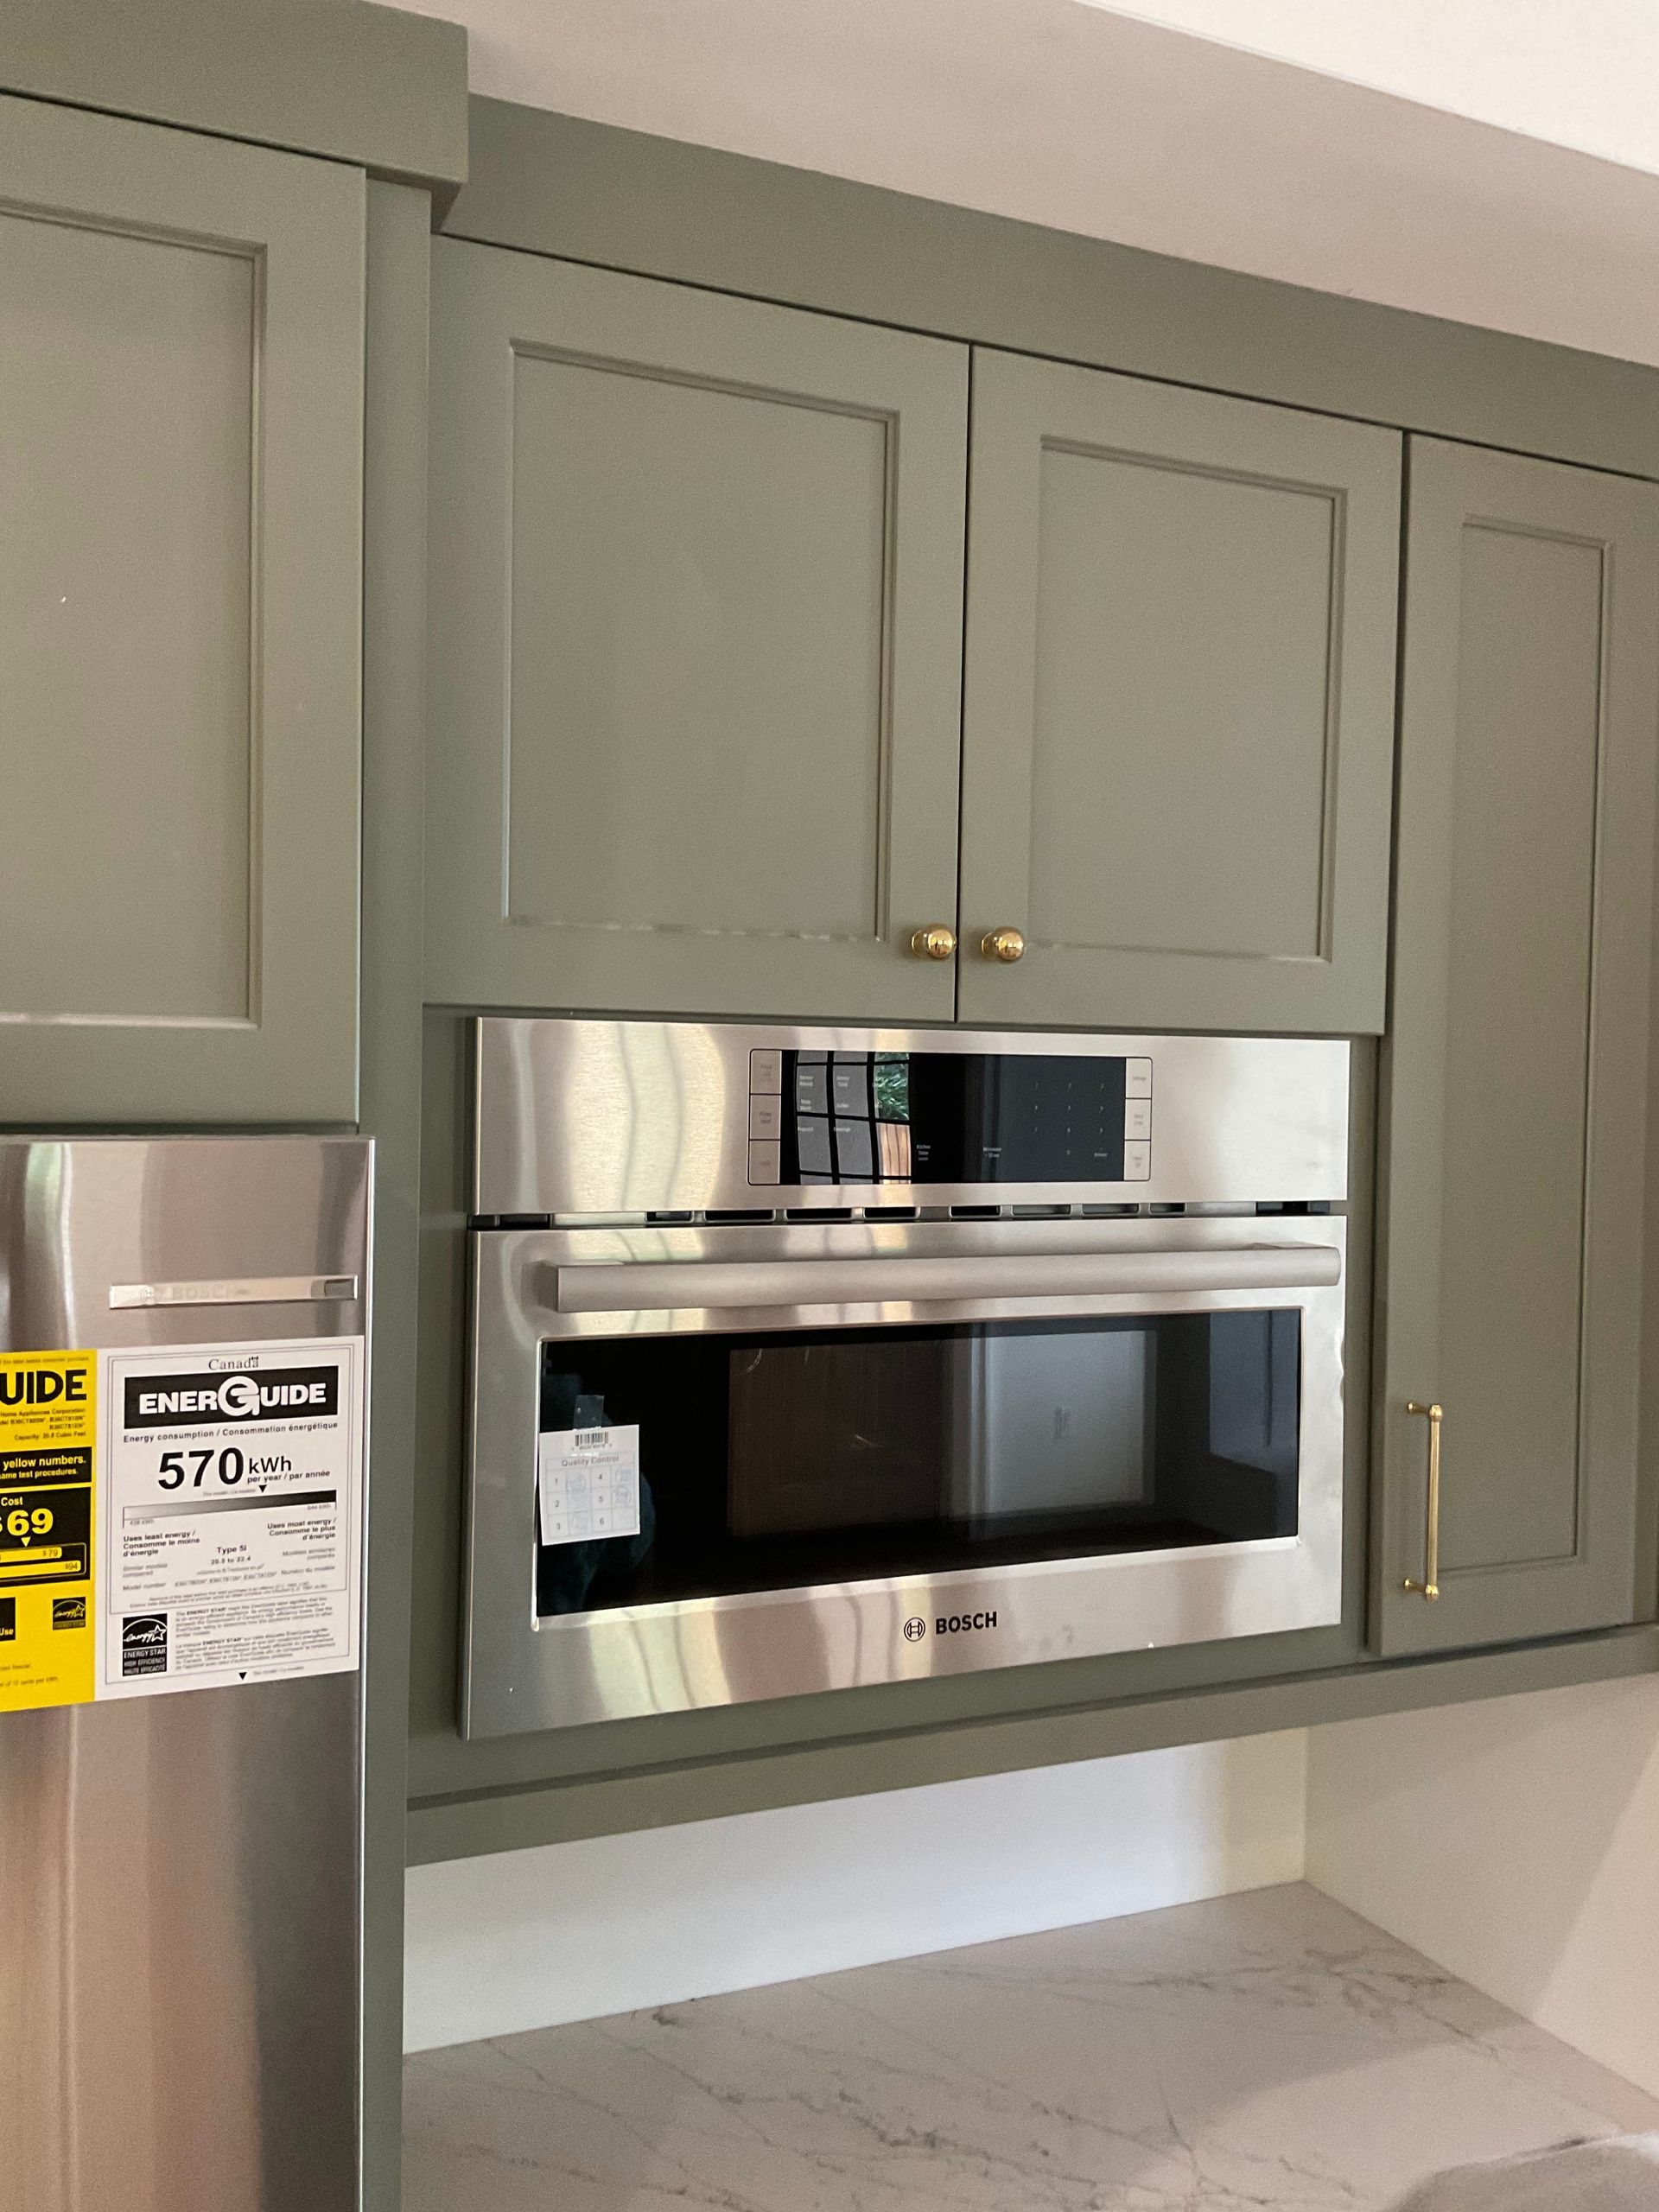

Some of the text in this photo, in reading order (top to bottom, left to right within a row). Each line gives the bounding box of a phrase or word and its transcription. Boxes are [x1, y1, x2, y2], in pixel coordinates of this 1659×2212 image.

[208, 1357, 259, 1370] Canada
[139, 1376, 327, 1417] ENERGUIDE
[124, 1434, 154, 1443] Energy
[157, 1430, 214, 1441] consumption
[222, 1425, 286, 1436] Consommation
[289, 1421, 338, 1432] énergétique
[3, 1455, 86, 1471] yellow numbers.
[158, 1447, 245, 1490] 570
[249, 1456, 292, 1474] kWh
[562, 1455, 620, 1467] Quality Control
[247, 1476, 261, 1484] per
[264, 1474, 282, 1484] year
[289, 1471, 303, 1481] par
[305, 1469, 330, 1478] année
[1, 1497, 23, 1506] Cost
[217, 1546, 237, 1554] Type
[935, 1611, 997, 1635] BOSCH
[124, 1648, 166, 1659] ENERGY STAR
